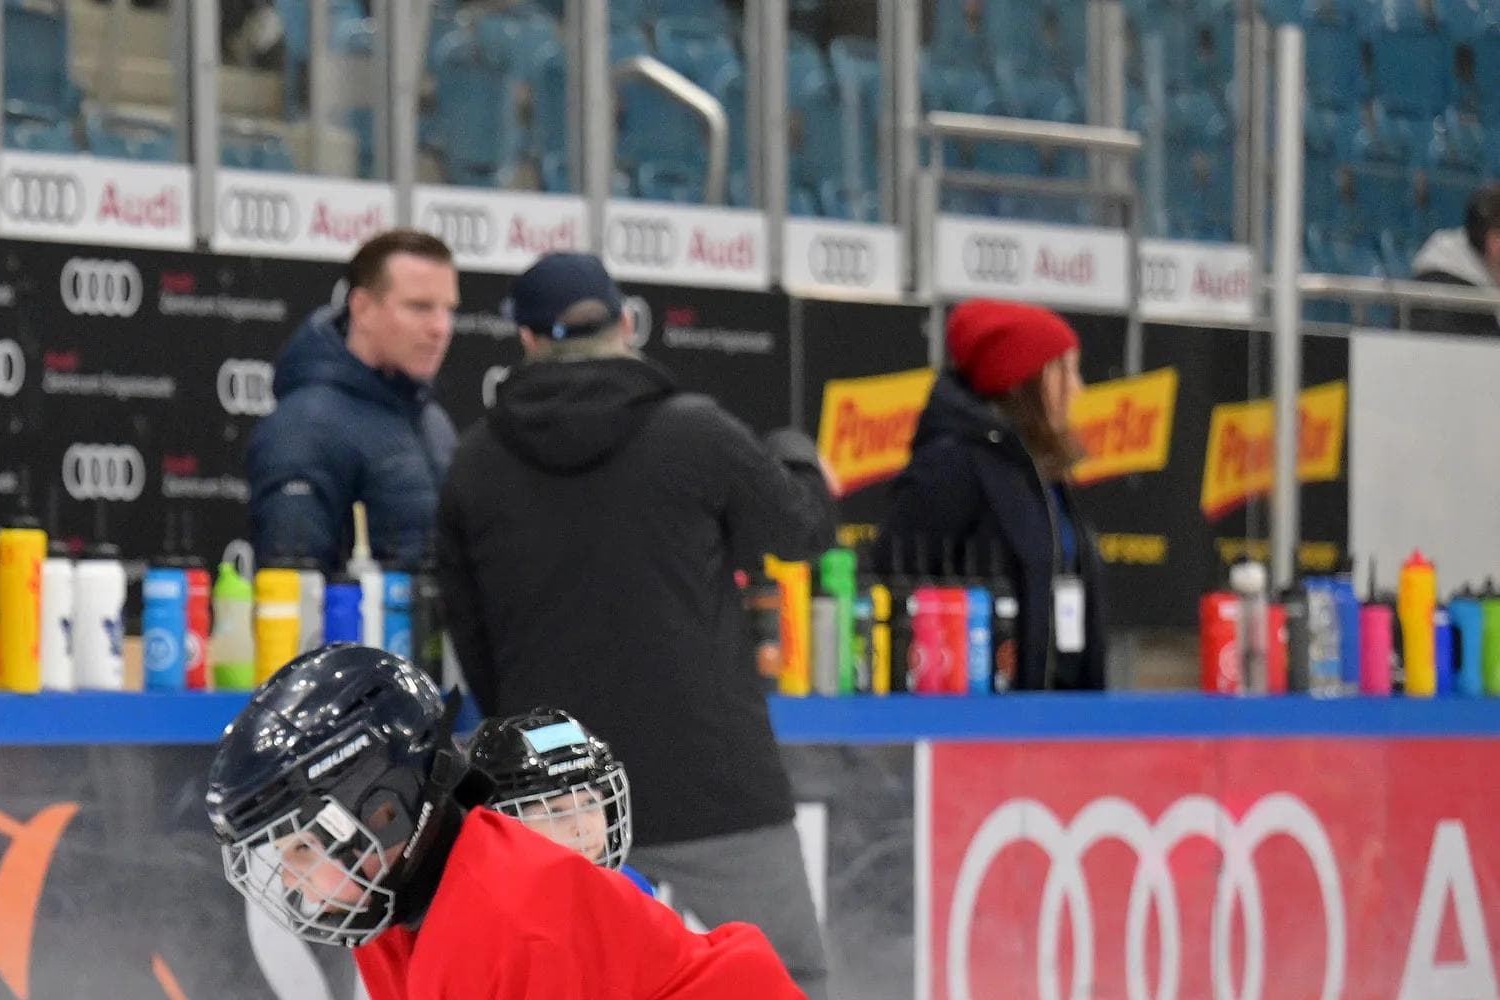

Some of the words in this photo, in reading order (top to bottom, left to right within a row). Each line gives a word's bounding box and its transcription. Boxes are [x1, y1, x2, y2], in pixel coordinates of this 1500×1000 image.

[100, 182, 181, 230] Audi
[687, 232, 757, 270] Audi
[1033, 242, 1095, 285] Audi
